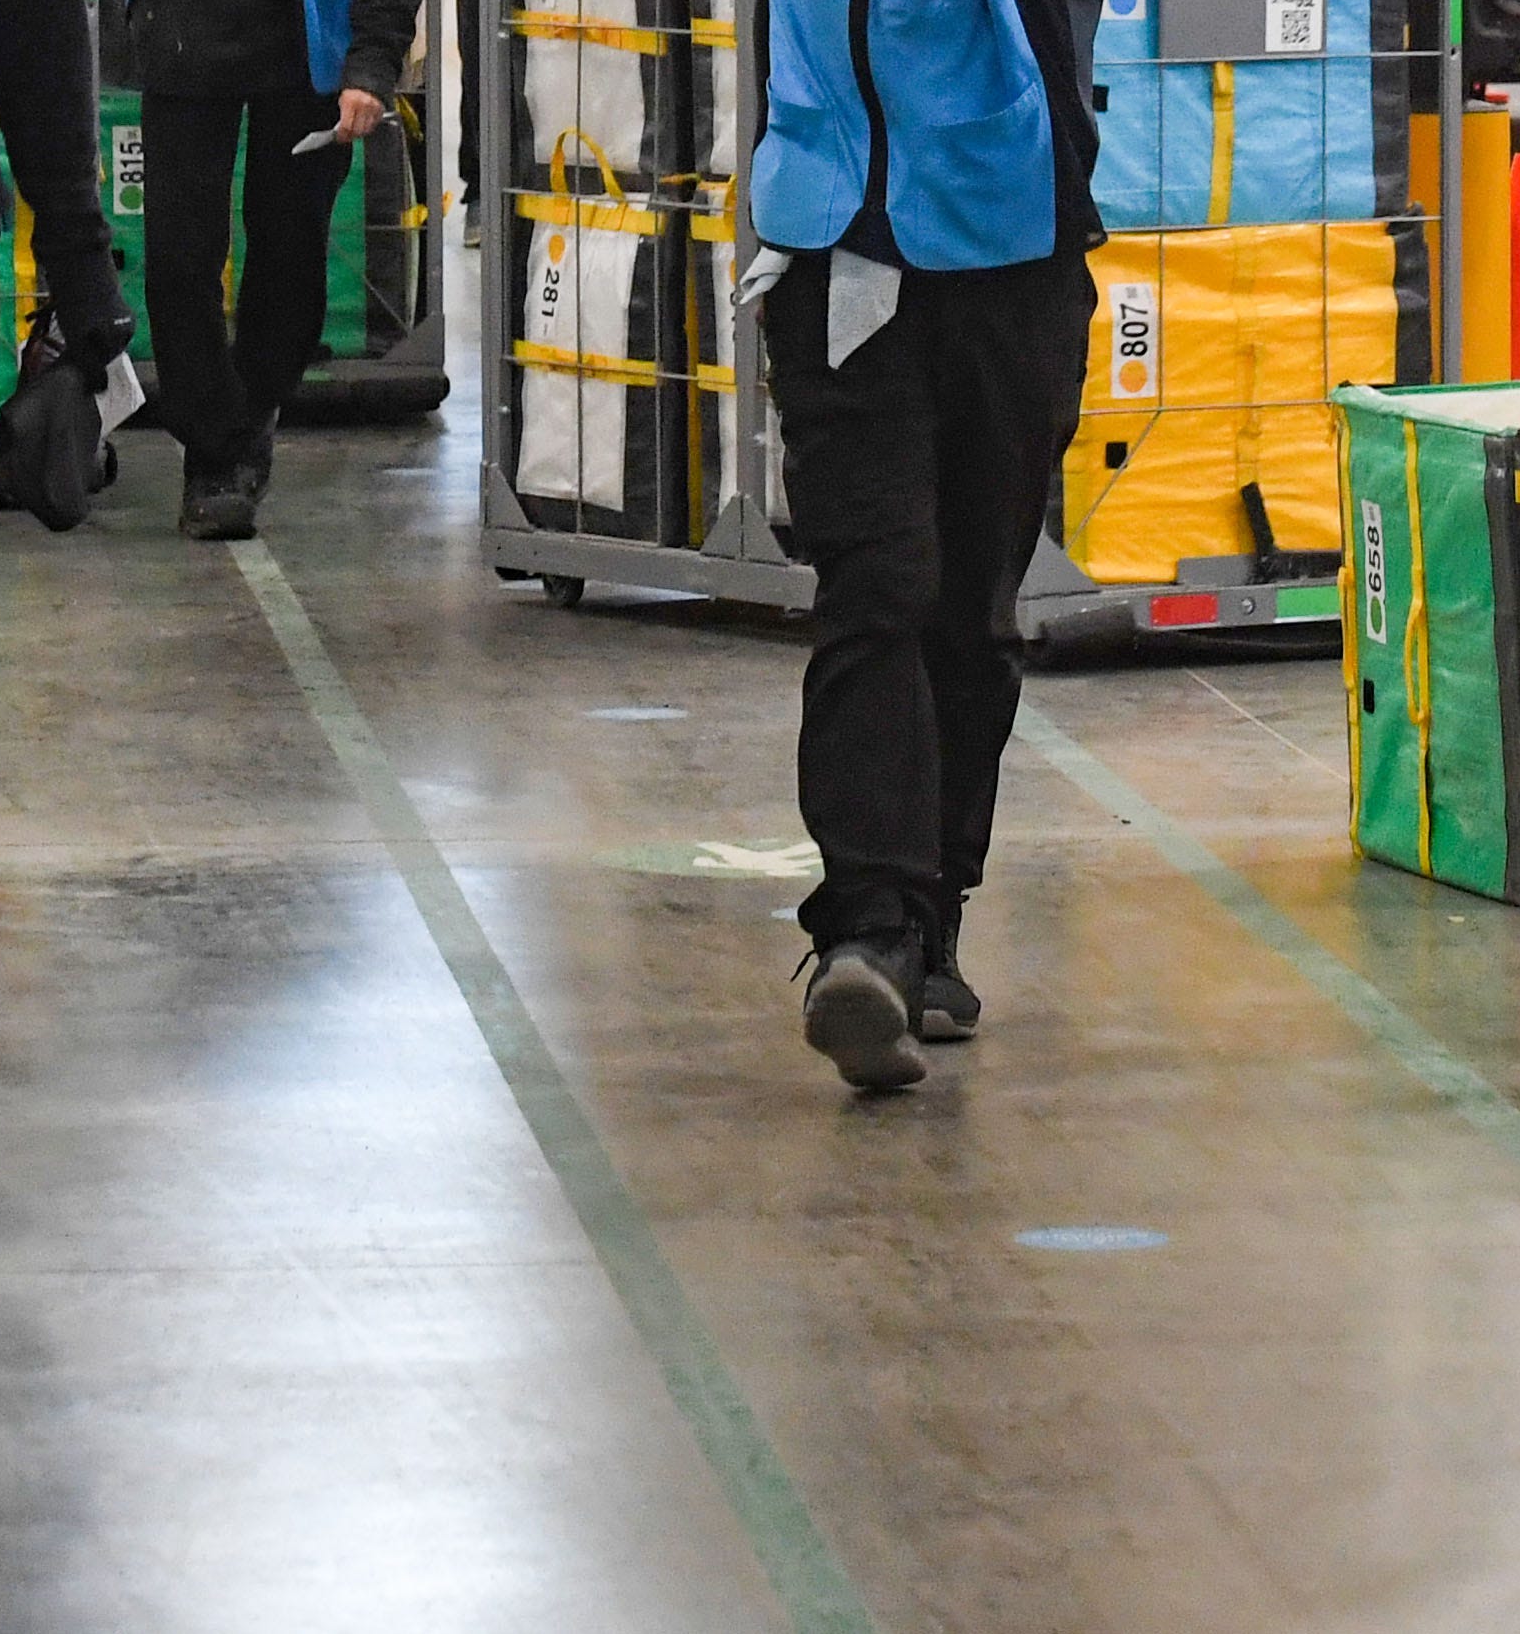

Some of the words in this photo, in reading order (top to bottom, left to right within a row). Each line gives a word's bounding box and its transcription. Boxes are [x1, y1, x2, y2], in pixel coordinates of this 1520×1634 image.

[120, 141, 144, 184] 815
[541, 267, 560, 318] 281
[1119, 303, 1149, 357] 807
[1367, 525, 1382, 593] 658
